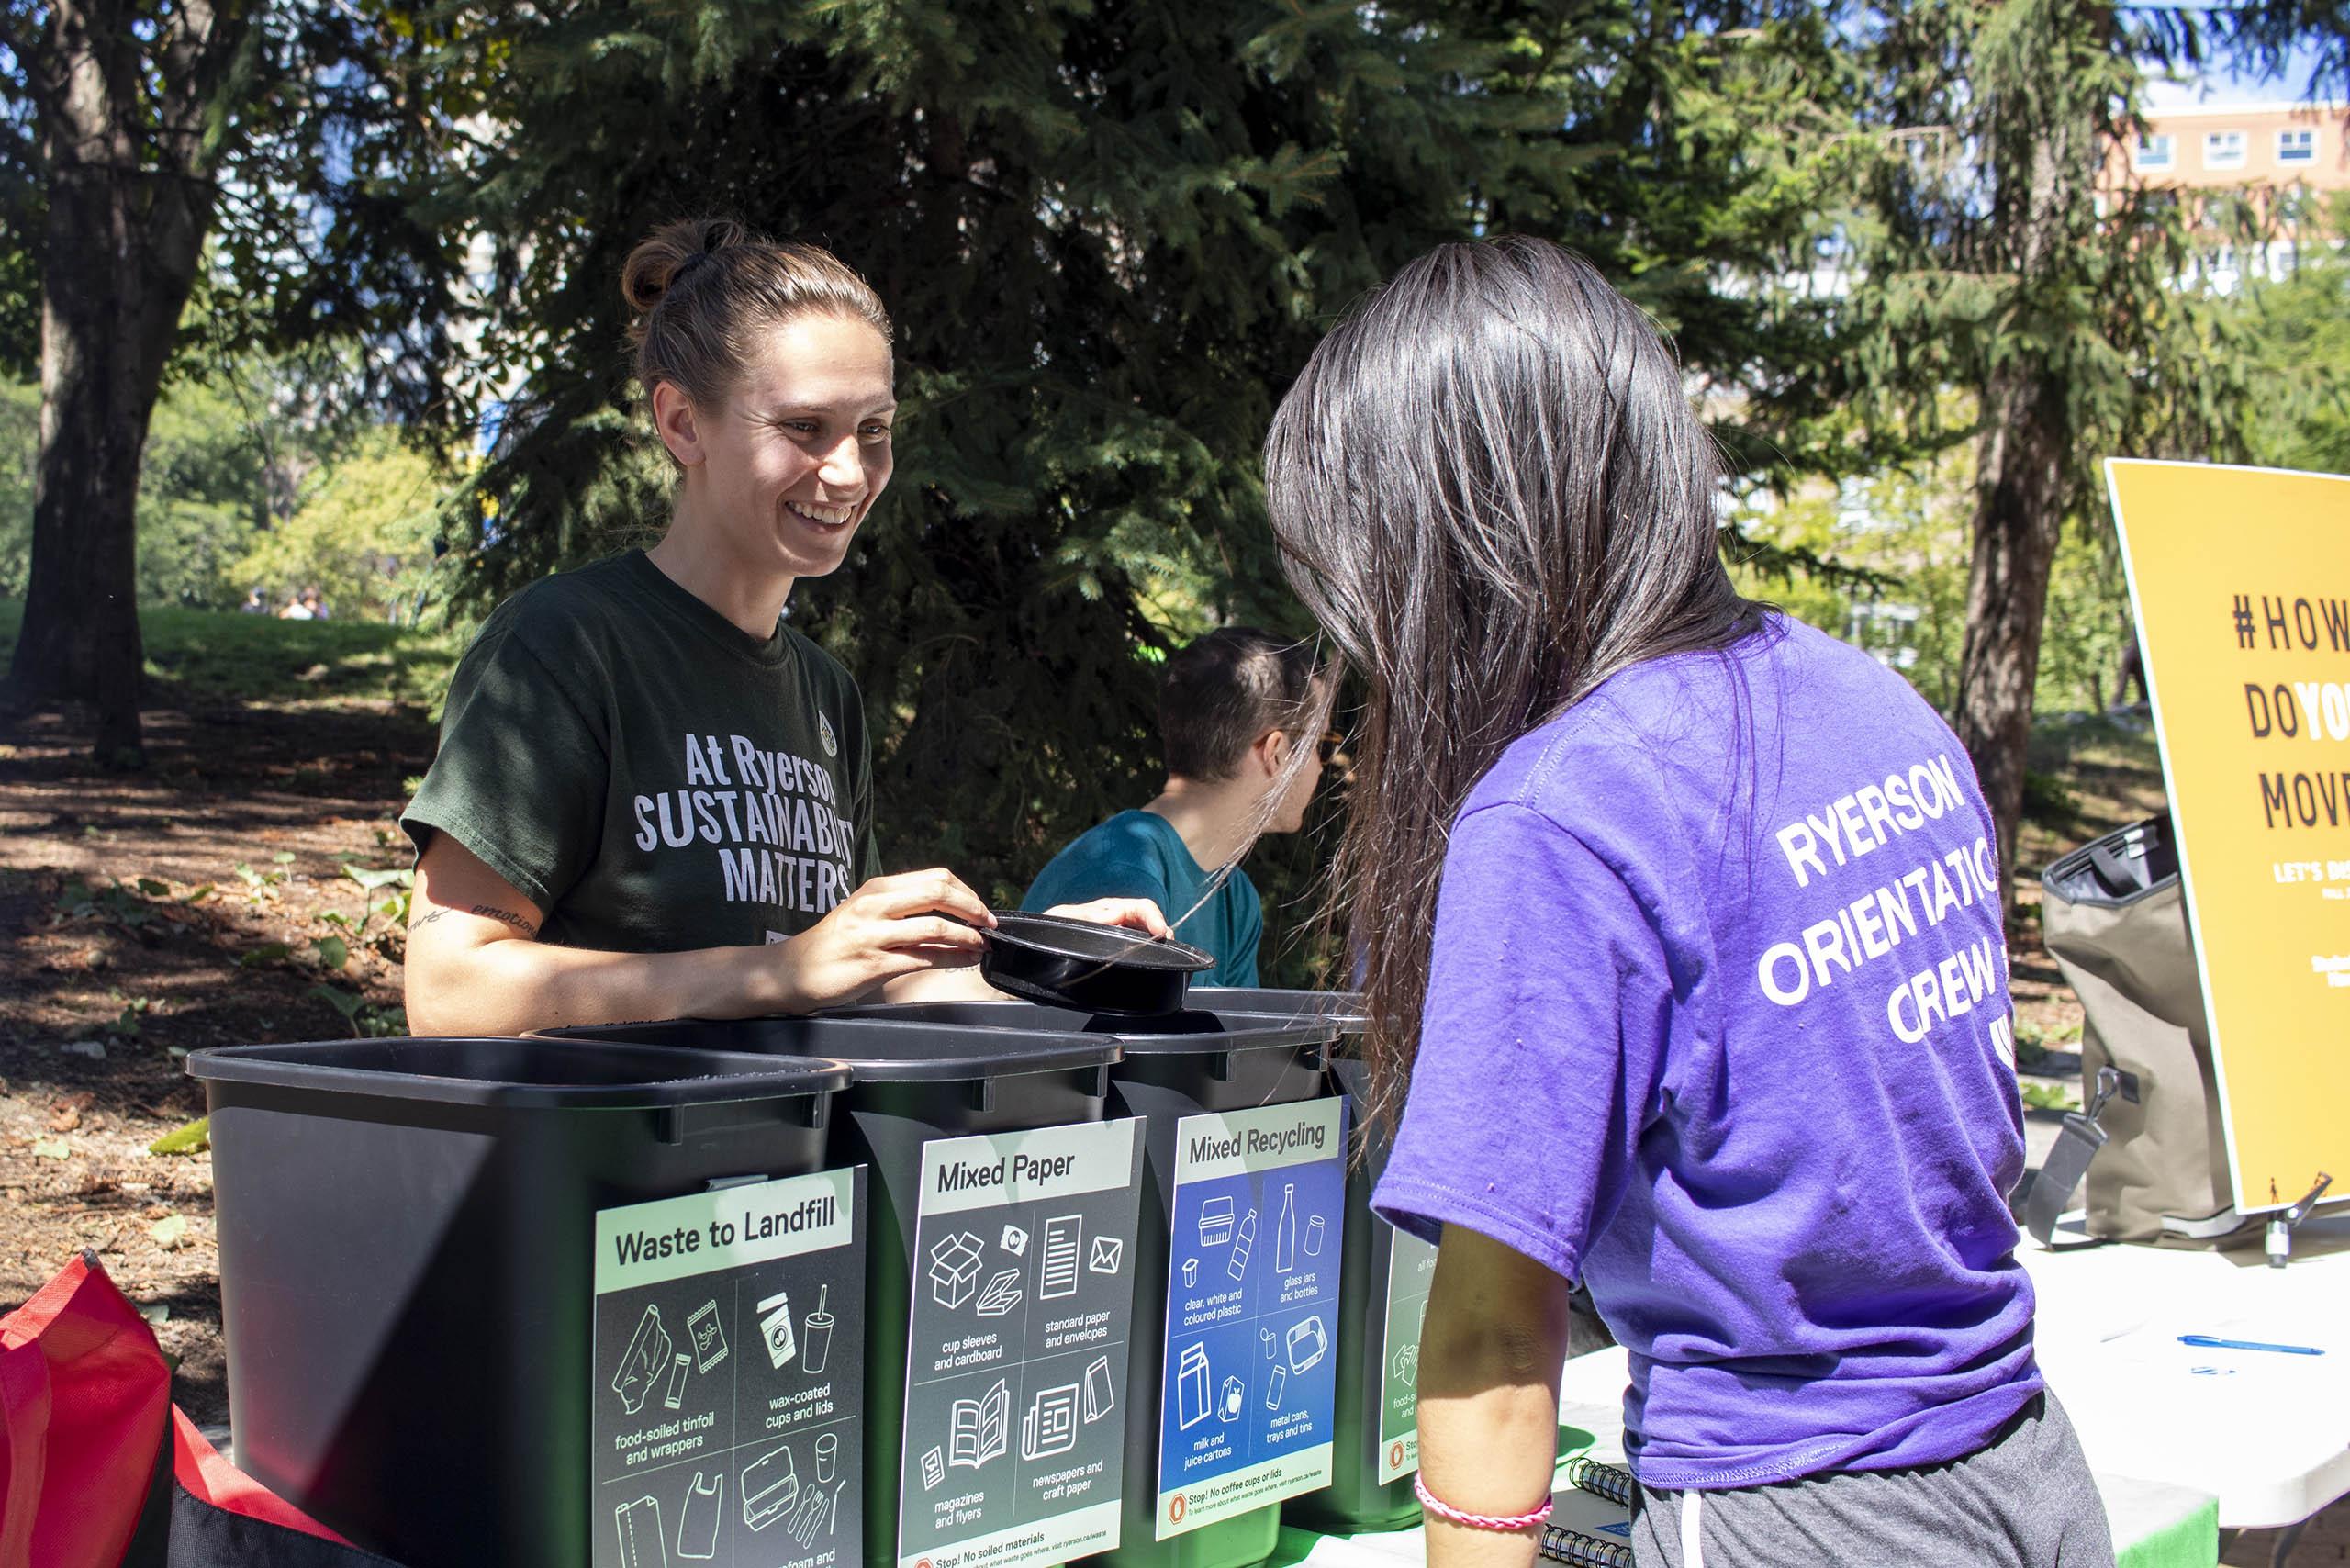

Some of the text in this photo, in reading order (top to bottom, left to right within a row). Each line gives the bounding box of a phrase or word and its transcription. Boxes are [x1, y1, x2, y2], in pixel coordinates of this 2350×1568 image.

[686, 733, 731, 786] At
[634, 790, 854, 869] SUSTAINABIT
[1775, 754, 1965, 889] RYERSON
[718, 848, 851, 914] MATTERS
[1758, 836, 1998, 1007] ORIENTATIO
[1886, 935, 1998, 1045] CREW
[1189, 1122, 1326, 1164] Mixed Recycling
[937, 1153, 1075, 1193] Mixed Paper
[616, 1196, 834, 1265] Waste to Landfill
[1284, 1271, 1315, 1289] glass jars
[1185, 1288, 1243, 1313] clear, white and
[1280, 1285, 1318, 1303] and bottles
[1045, 1310, 1110, 1333] standard paper
[1184, 1303, 1242, 1327] coloured plastic
[942, 1332, 997, 1355] cup sleeves
[1046, 1326, 1107, 1349] and envelopes
[934, 1347, 1002, 1371] and cardboard
[769, 1383, 831, 1411] wax-coated
[766, 1400, 834, 1429] cups and lids
[1270, 1411, 1309, 1428] metal cans,
[1401, 1406, 1414, 1418] and
[615, 1411, 714, 1450] food-soiled tinfoil
[1193, 1432, 1225, 1451] milk and
[1266, 1421, 1313, 1445] trays and tins
[626, 1435, 703, 1465] and wrappers
[1184, 1448, 1232, 1471] juice cartons
[1033, 1459, 1102, 1488] newspapers and
[1043, 1479, 1091, 1501] craft paper
[1189, 1468, 1282, 1505] Stop! No coffee cups or lids
[934, 1491, 984, 1514] magazines
[935, 1506, 982, 1529] and flyers
[817, 1547, 835, 1565] and
[936, 1531, 1045, 1568] Stop! No soiled materials
